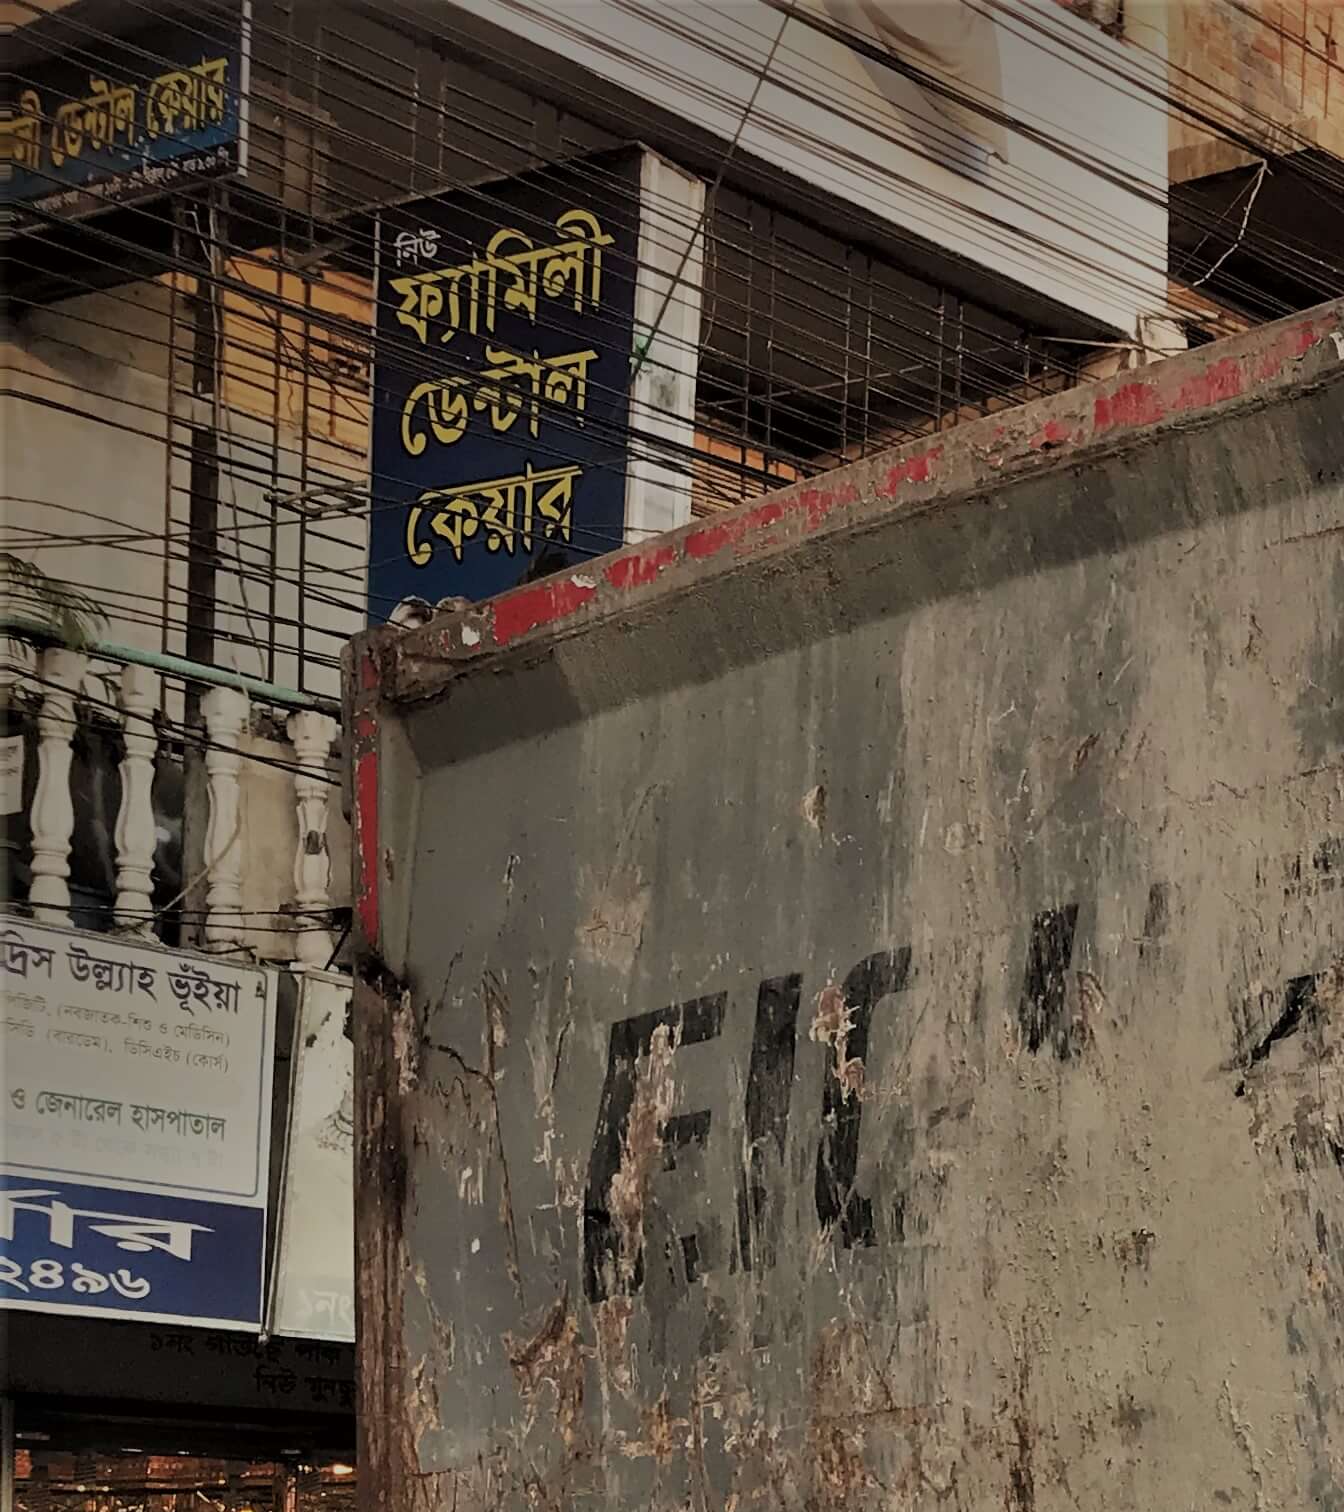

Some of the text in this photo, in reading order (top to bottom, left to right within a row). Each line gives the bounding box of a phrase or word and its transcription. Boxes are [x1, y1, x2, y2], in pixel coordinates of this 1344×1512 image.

[52, 73, 140, 168] ডেন্টাল
[146, 55, 229, 139] কেয়ার
[388, 209, 615, 343] ফ্যামিলী
[393, 228, 441, 267] নিউ
[402, 344, 599, 455] ডেন্টাল
[407, 461, 583, 565] কেয়ার
[36, 1090, 122, 1126] জেনারেল
[130, 1104, 227, 1142] হাসপাতাল
